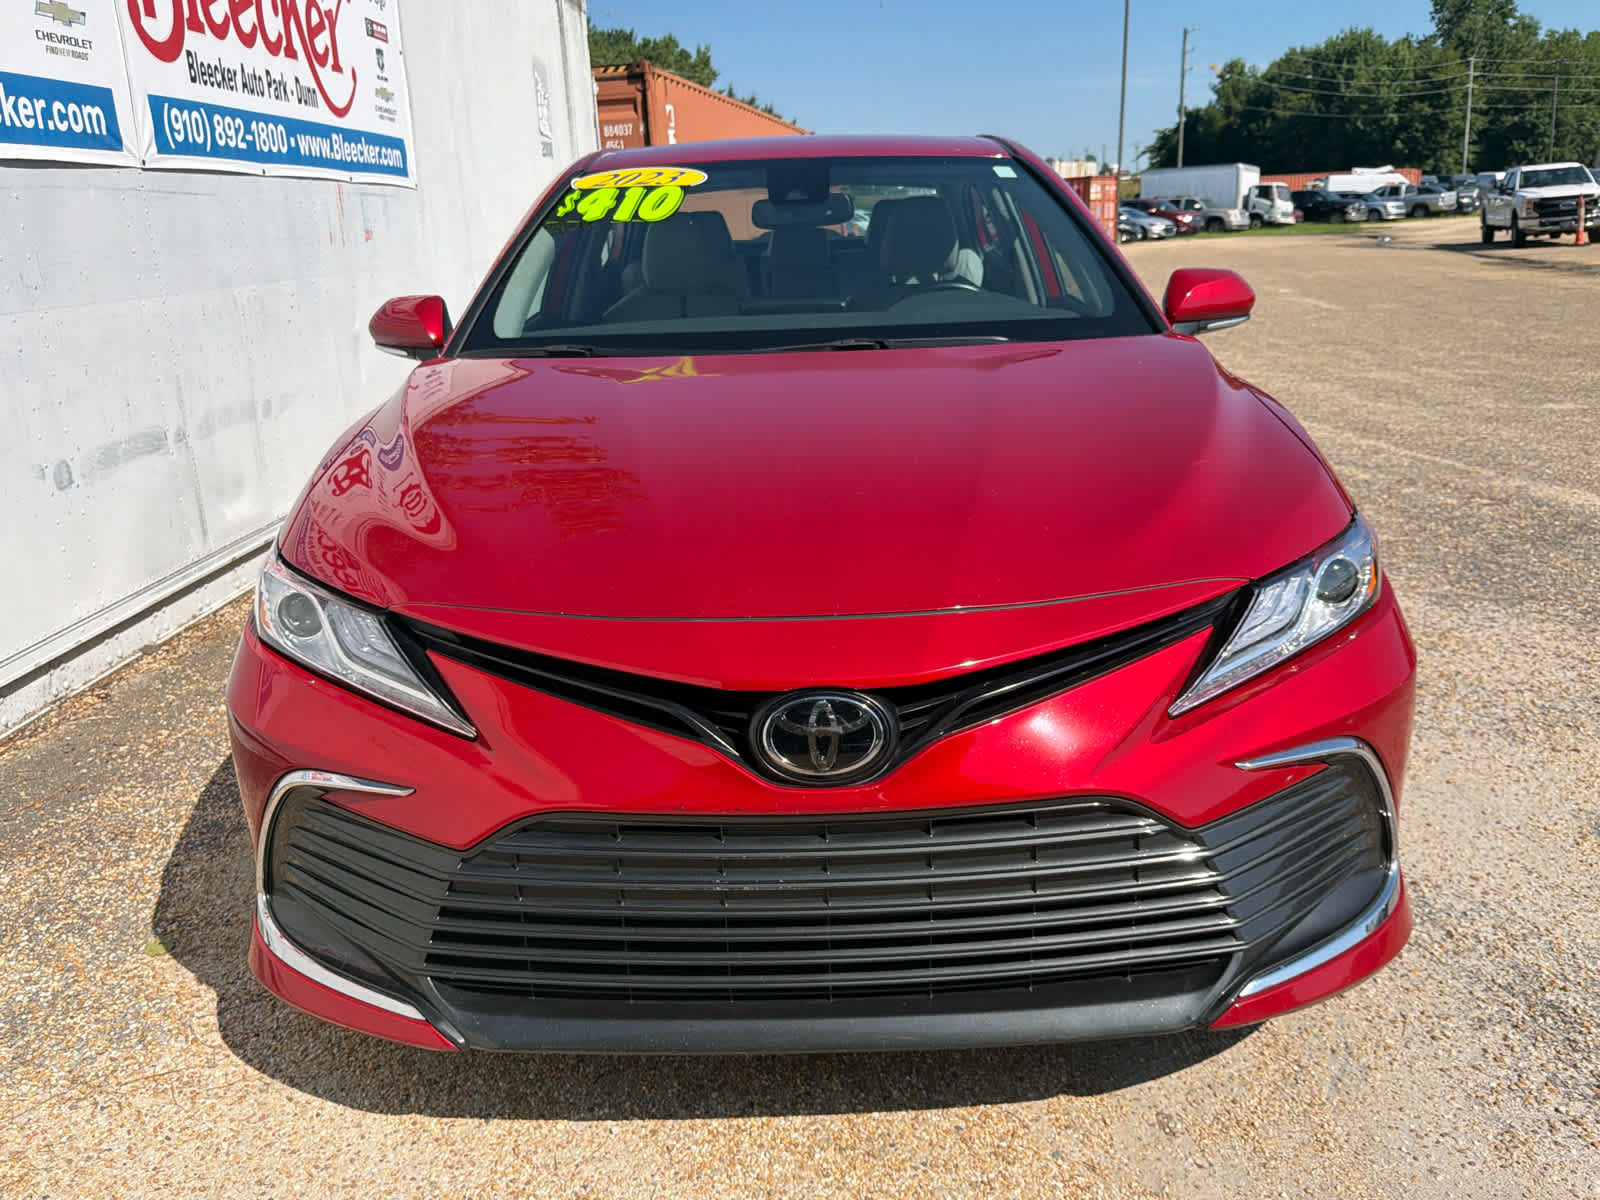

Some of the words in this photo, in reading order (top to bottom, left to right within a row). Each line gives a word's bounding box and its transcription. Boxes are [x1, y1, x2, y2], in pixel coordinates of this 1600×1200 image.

[35, 29, 93, 50] CHEVROLET
[127, 0, 357, 118] eecker
[186, 49, 238, 92] Bleecker
[240, 62, 265, 98] Auto
[265, 68, 290, 102] Park
[294, 75, 319, 108] Dunn
[0, 82, 107, 136] ker.com
[164, 102, 211, 152] (910)
[213, 113, 288, 154] 892-1800
[296, 133, 404, 169] www.Bleecker.com
[556, 186, 685, 222] $410
[592, 171, 687, 187] 2023
